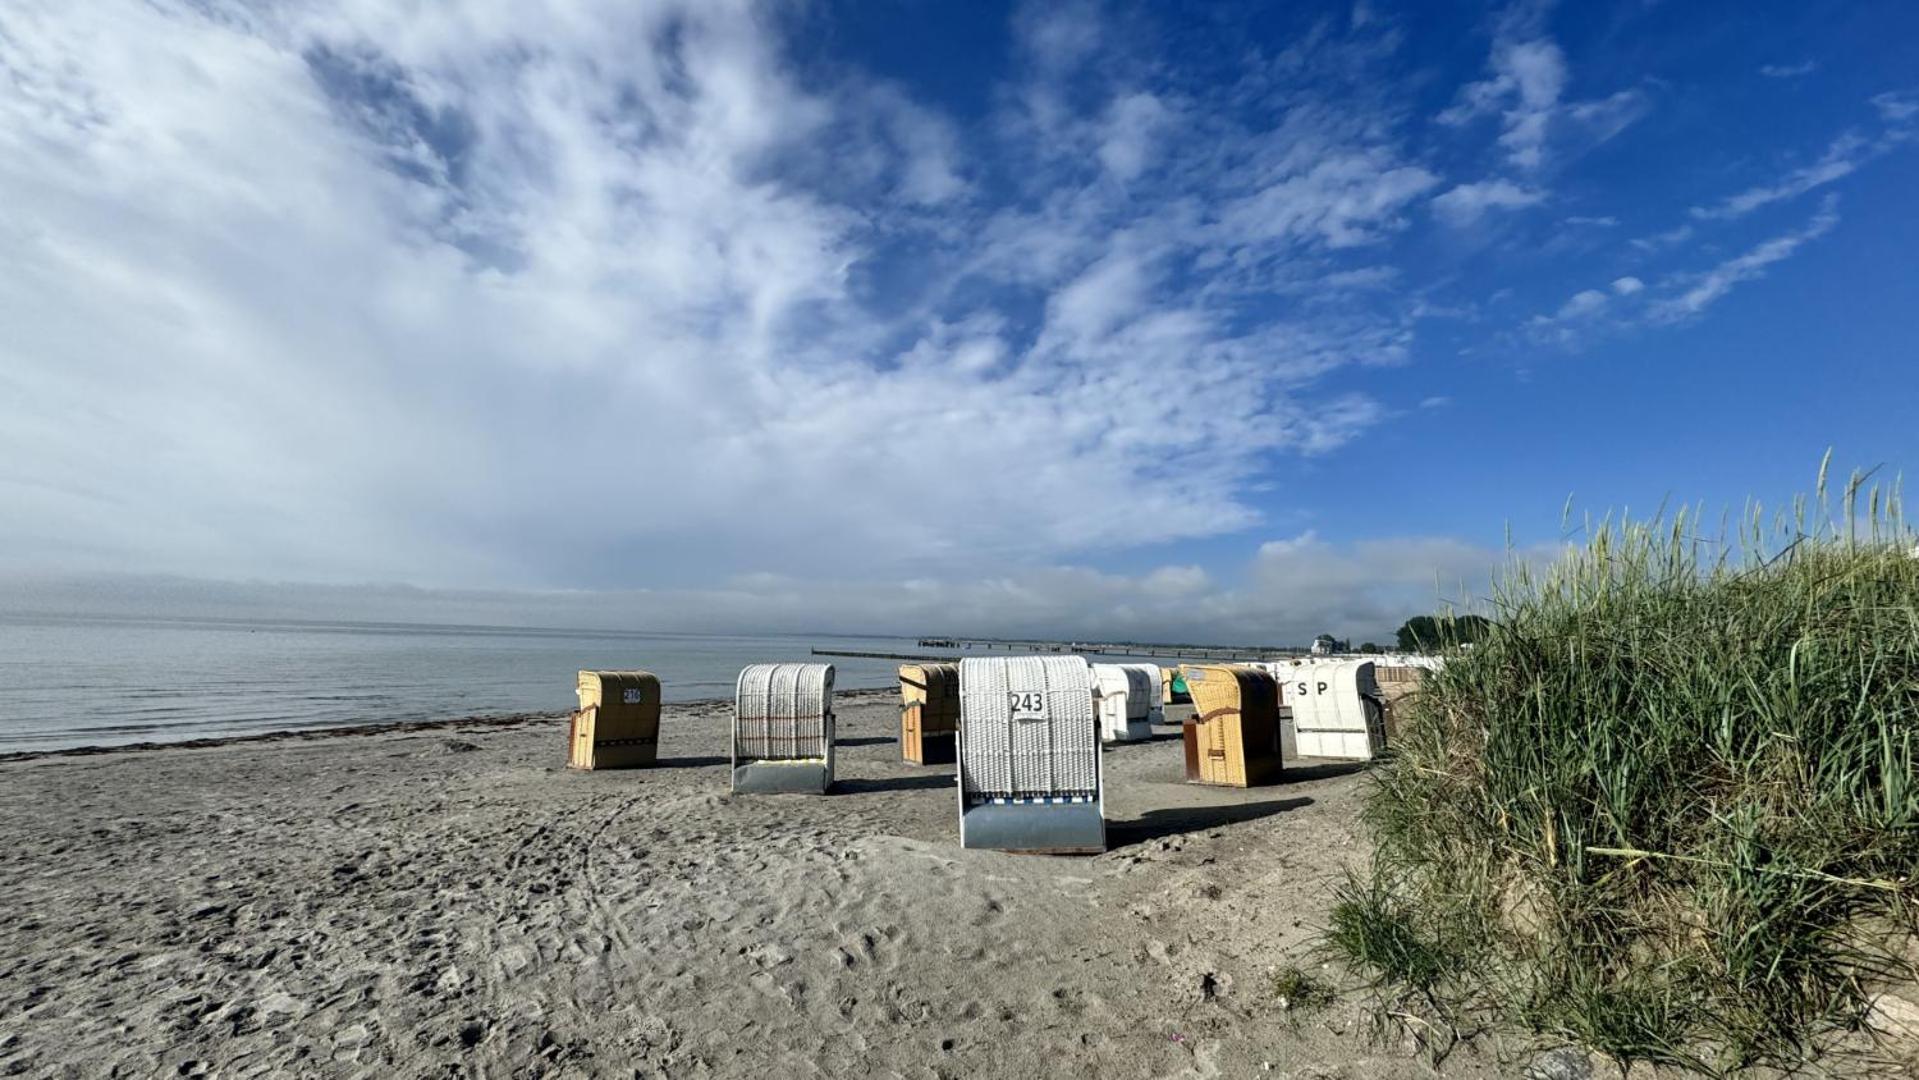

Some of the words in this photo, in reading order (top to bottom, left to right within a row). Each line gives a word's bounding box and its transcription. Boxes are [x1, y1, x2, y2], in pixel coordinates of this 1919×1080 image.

[1298, 681, 1307, 696] S
[1317, 681, 1328, 696] P
[1010, 693, 1043, 712] 243
